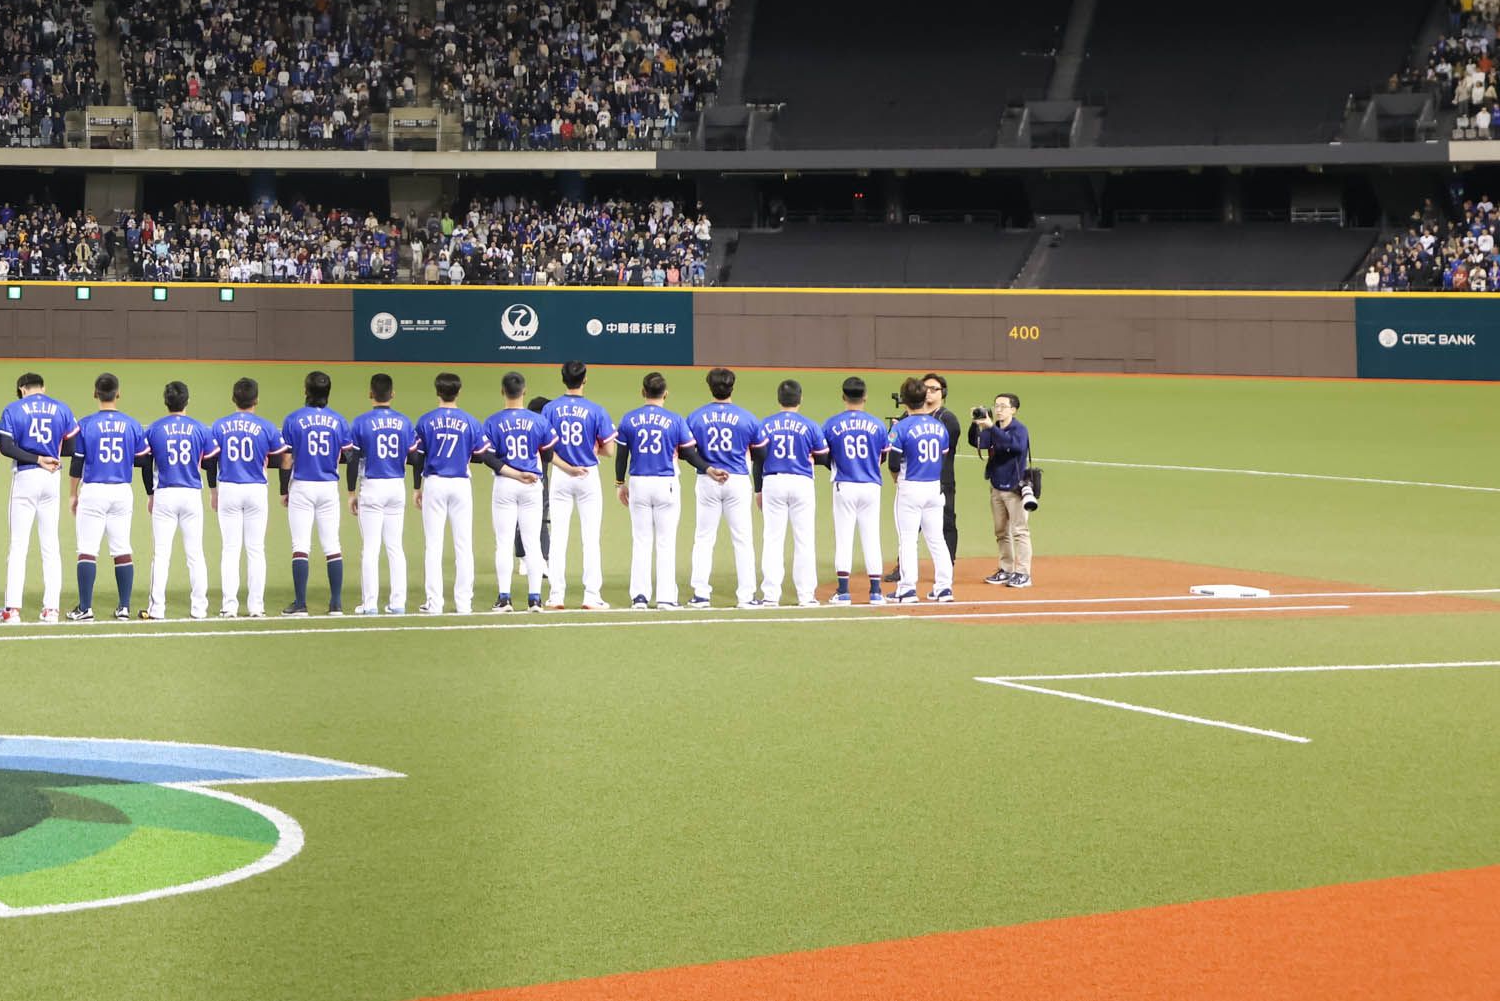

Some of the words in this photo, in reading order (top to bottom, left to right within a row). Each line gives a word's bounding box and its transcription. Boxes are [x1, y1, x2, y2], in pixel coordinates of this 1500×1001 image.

[1008, 326, 1040, 340] 400
[1402, 333, 1436, 345] CTBC
[1438, 334, 1477, 346] BANK
[28, 418, 53, 444] 45
[163, 423, 194, 436] Y.C.LU
[221, 420, 262, 436] J.Y.TSENG
[560, 421, 583, 446] 98
[707, 426, 733, 452] 28
[99, 437, 124, 463] 55
[166, 439, 192, 465] 58
[226, 436, 254, 462] 60
[307, 431, 330, 456] 65
[376, 433, 399, 459] 69
[436, 433, 459, 458] 77
[505, 435, 528, 460] 96
[637, 428, 662, 454] 23
[773, 434, 797, 459] 31
[843, 434, 869, 460] 66
[918, 438, 940, 463] 90
